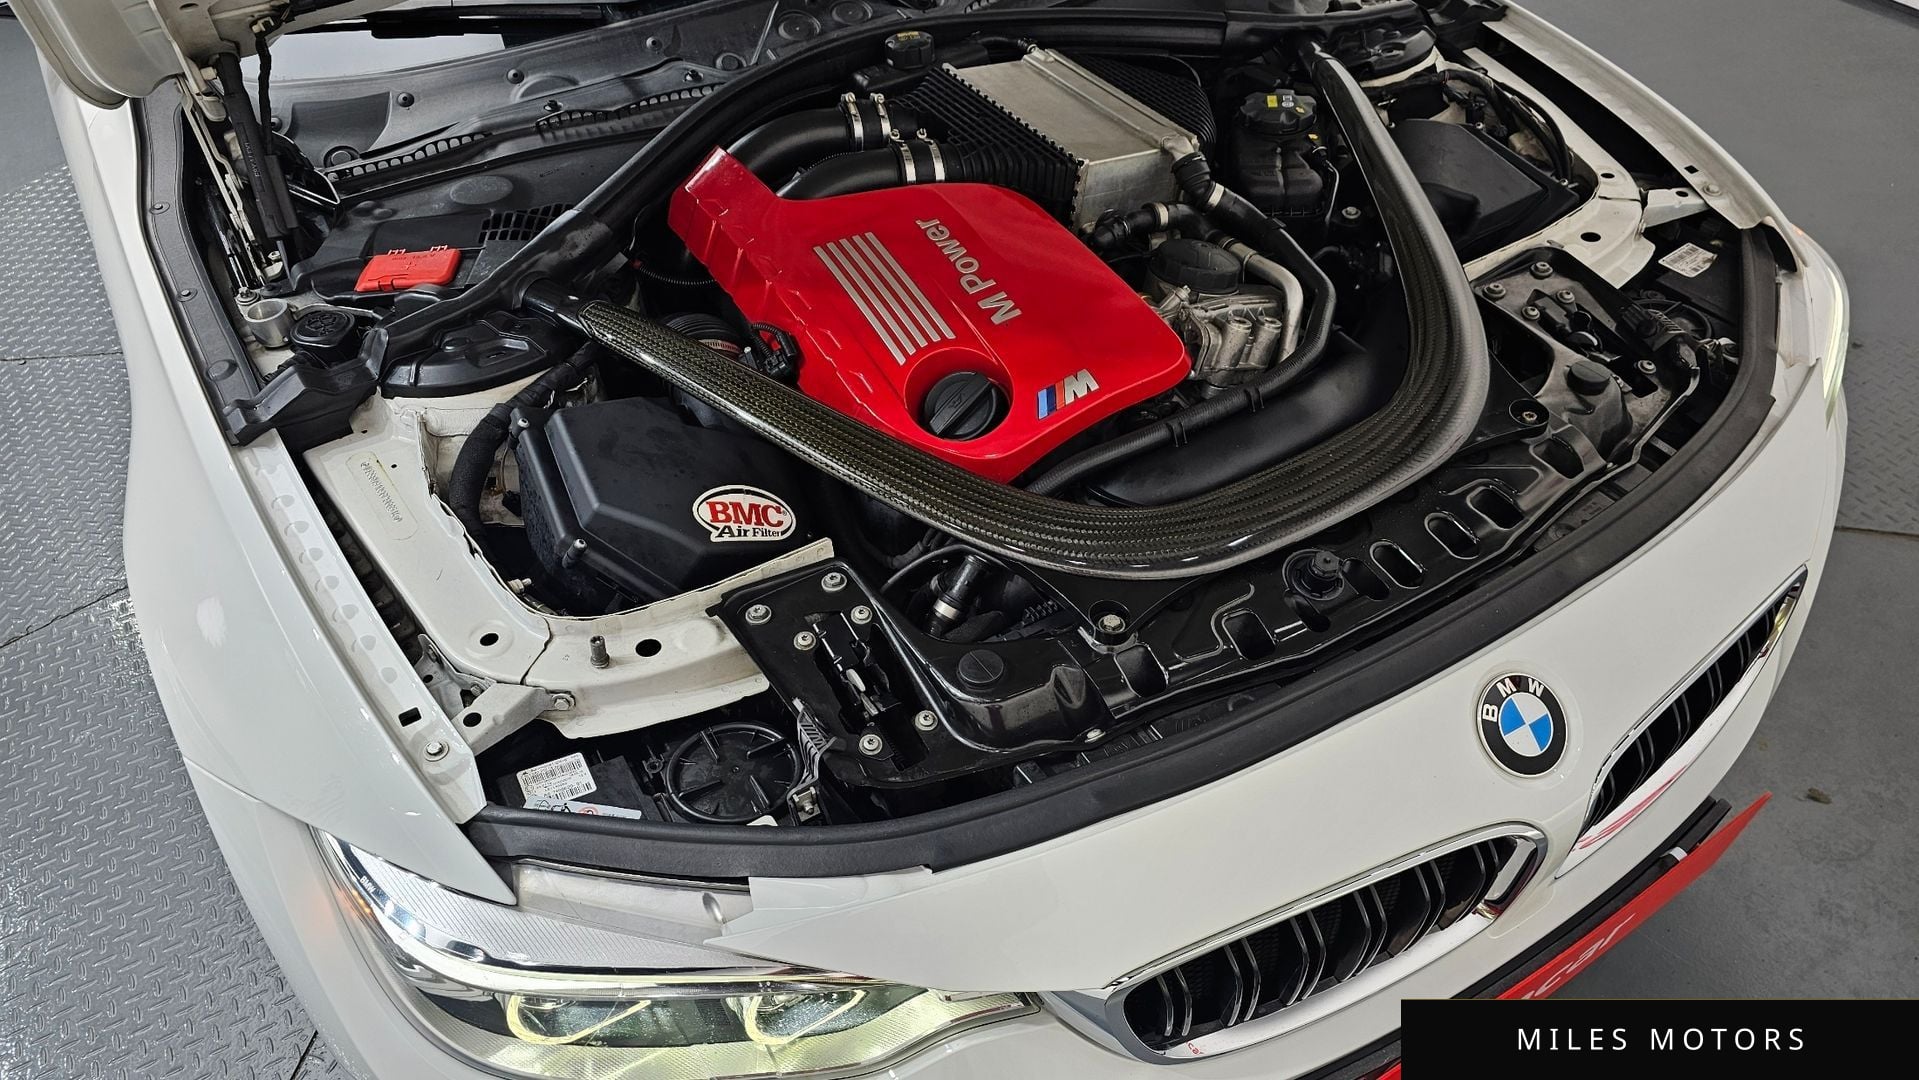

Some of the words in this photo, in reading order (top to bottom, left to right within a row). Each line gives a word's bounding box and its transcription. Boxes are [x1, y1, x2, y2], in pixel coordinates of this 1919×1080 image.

[915, 219, 997, 295] Power
[977, 291, 1022, 325] M
[705, 500, 785, 528] BMC
[714, 524, 750, 539] Air
[751, 527, 783, 538] Filter
[1481, 676, 1545, 723] BMW
